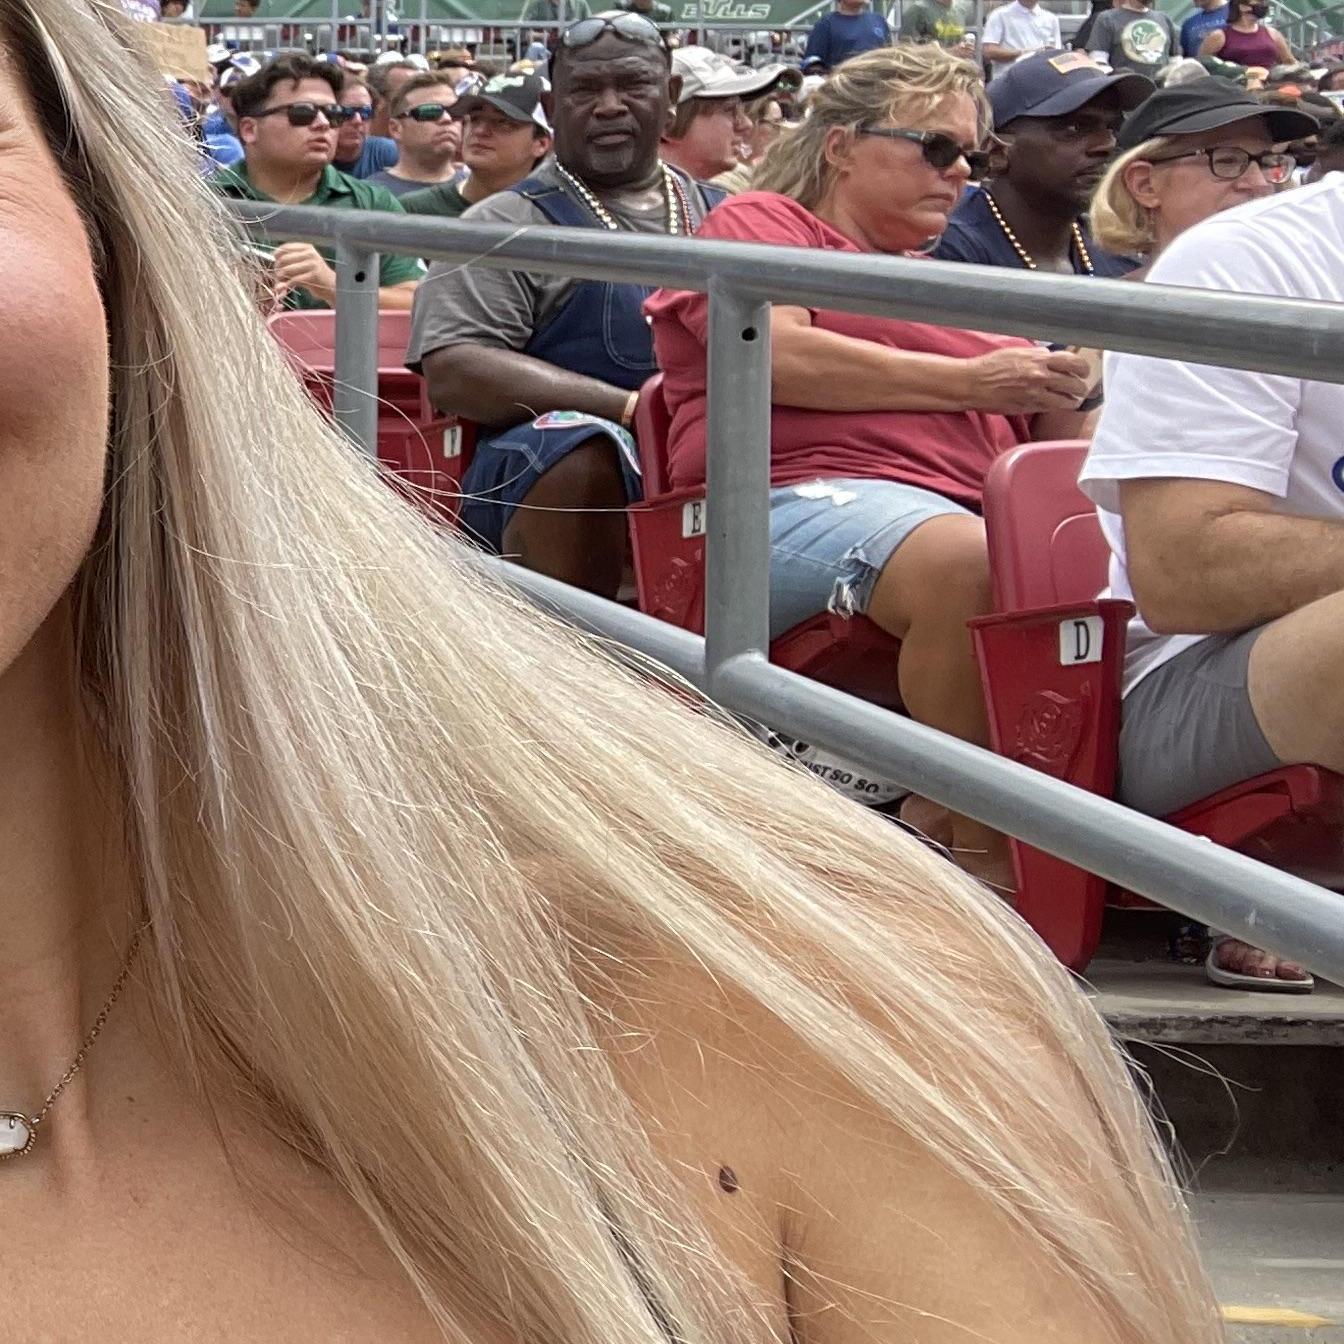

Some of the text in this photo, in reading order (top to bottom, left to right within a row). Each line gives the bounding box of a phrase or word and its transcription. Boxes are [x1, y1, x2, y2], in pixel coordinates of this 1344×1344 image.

[691, 501, 702, 534] E
[1073, 620, 1090, 661] D
[829, 769, 853, 785] SO
